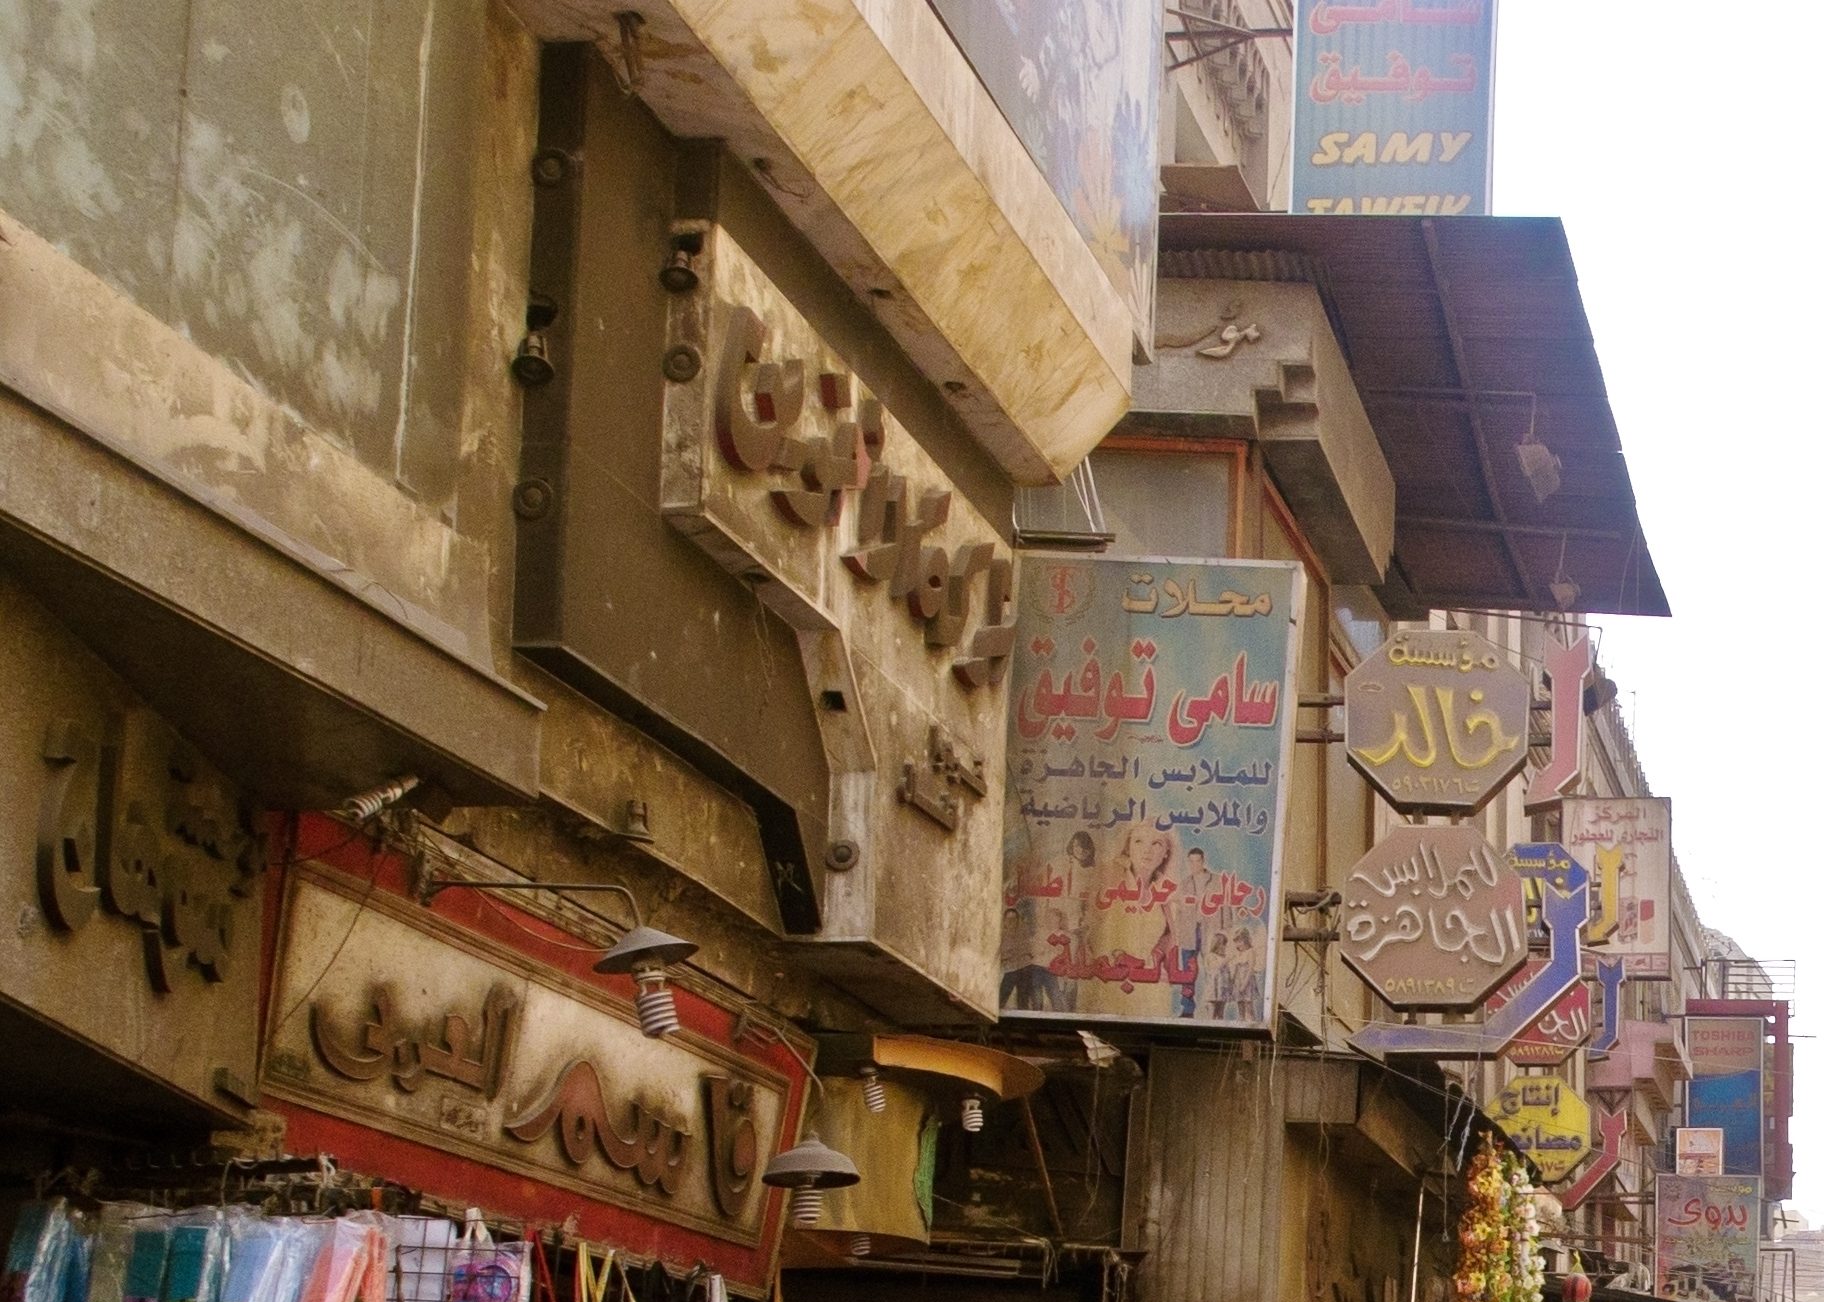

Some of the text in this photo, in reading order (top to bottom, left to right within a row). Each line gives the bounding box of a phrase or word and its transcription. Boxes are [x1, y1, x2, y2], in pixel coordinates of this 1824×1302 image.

[1309, 50, 1476, 106] توفيق
[1311, 131, 1473, 166] SAMY
[1121, 572, 1274, 619] محلات
[1388, 636, 1498, 672] مؤسسة
[1016, 635, 1280, 748] سامى توفيق
[1352, 680, 1521, 768] خالد
[1147, 757, 1272, 792] للملابس
[1155, 800, 1268, 834] والملابس
[1349, 840, 1499, 900] للملابس
[1200, 871, 1266, 918] رجالى
[1347, 899, 1522, 966] الجاهزة
[1691, 1027, 1756, 1043] TOSHIBA
[1693, 1046, 1754, 1058] SHARP
[1667, 1197, 1749, 1231] بدوى
